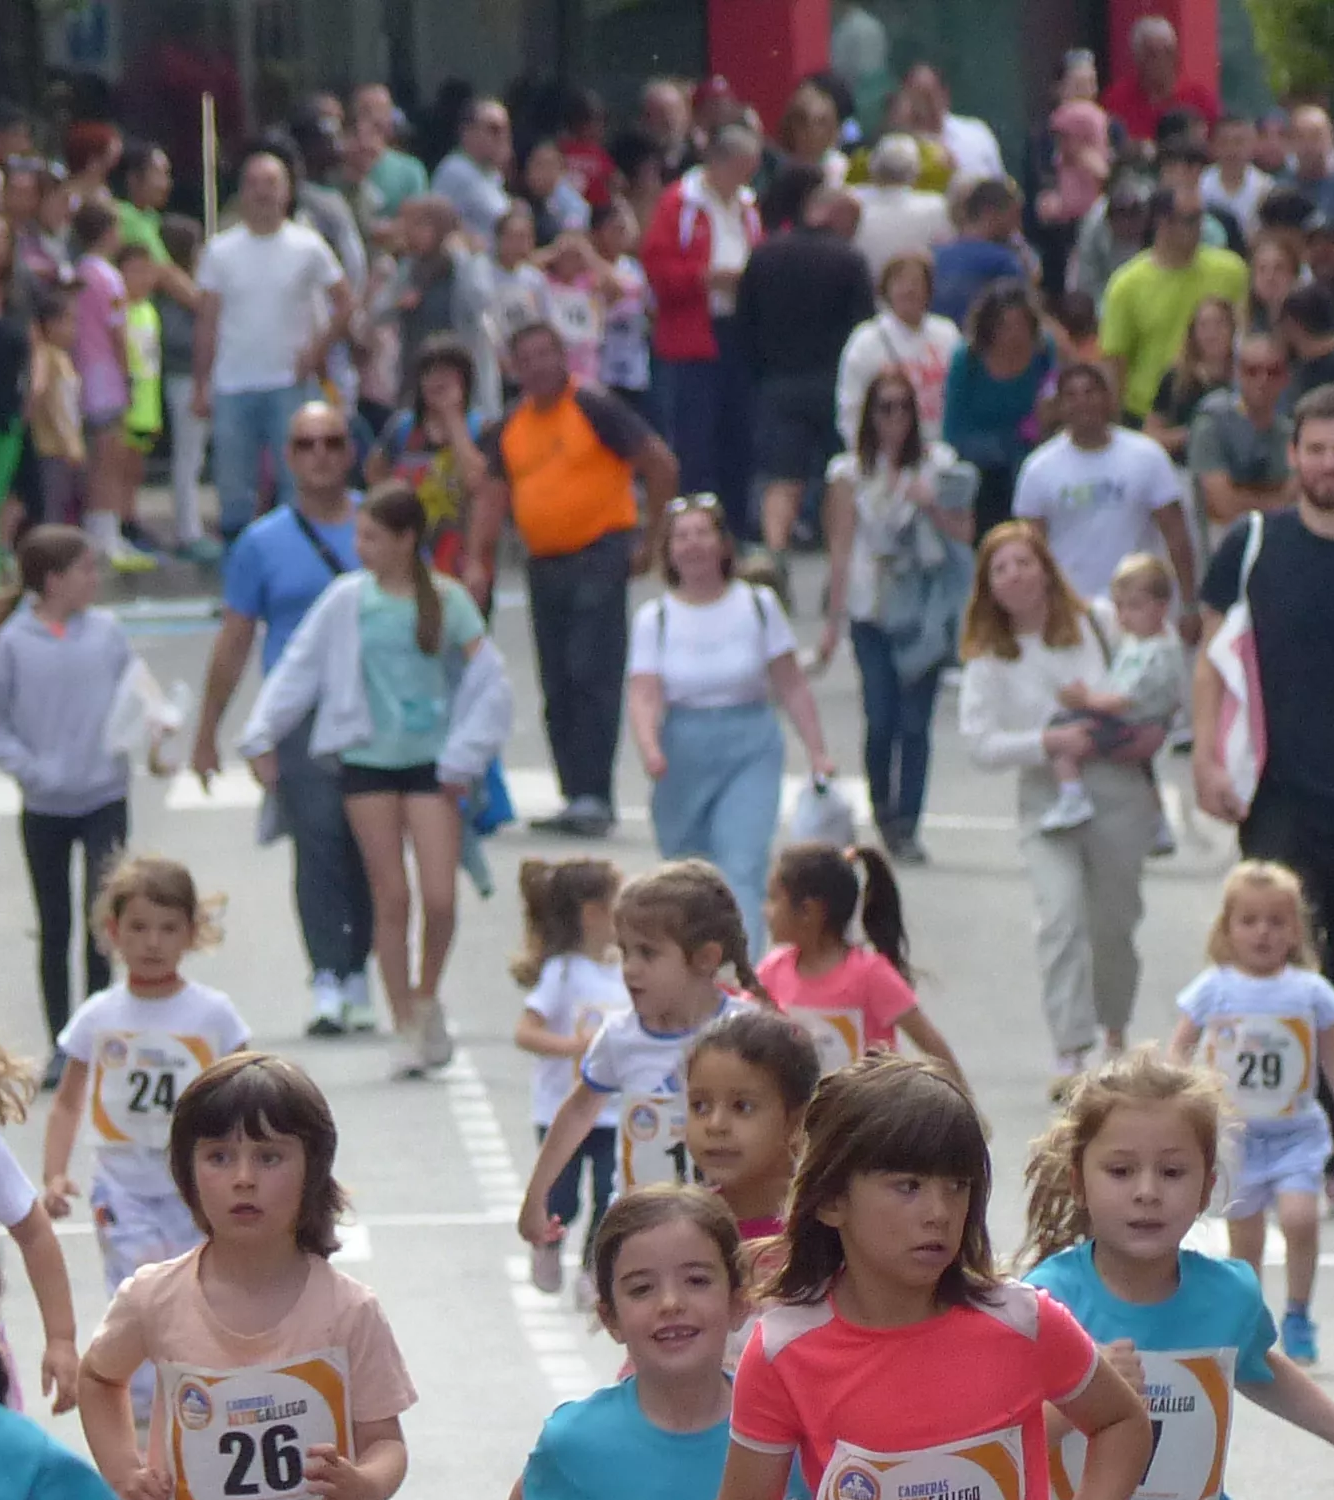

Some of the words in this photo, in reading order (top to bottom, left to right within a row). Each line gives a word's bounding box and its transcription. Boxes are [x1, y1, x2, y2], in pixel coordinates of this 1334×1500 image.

[1237, 1051, 1281, 1090] 29
[128, 1069, 175, 1113] 24
[1149, 1395, 1195, 1413] GALLEGO
[218, 1423, 303, 1496] 26
[897, 1479, 950, 1498] CARRERAS
